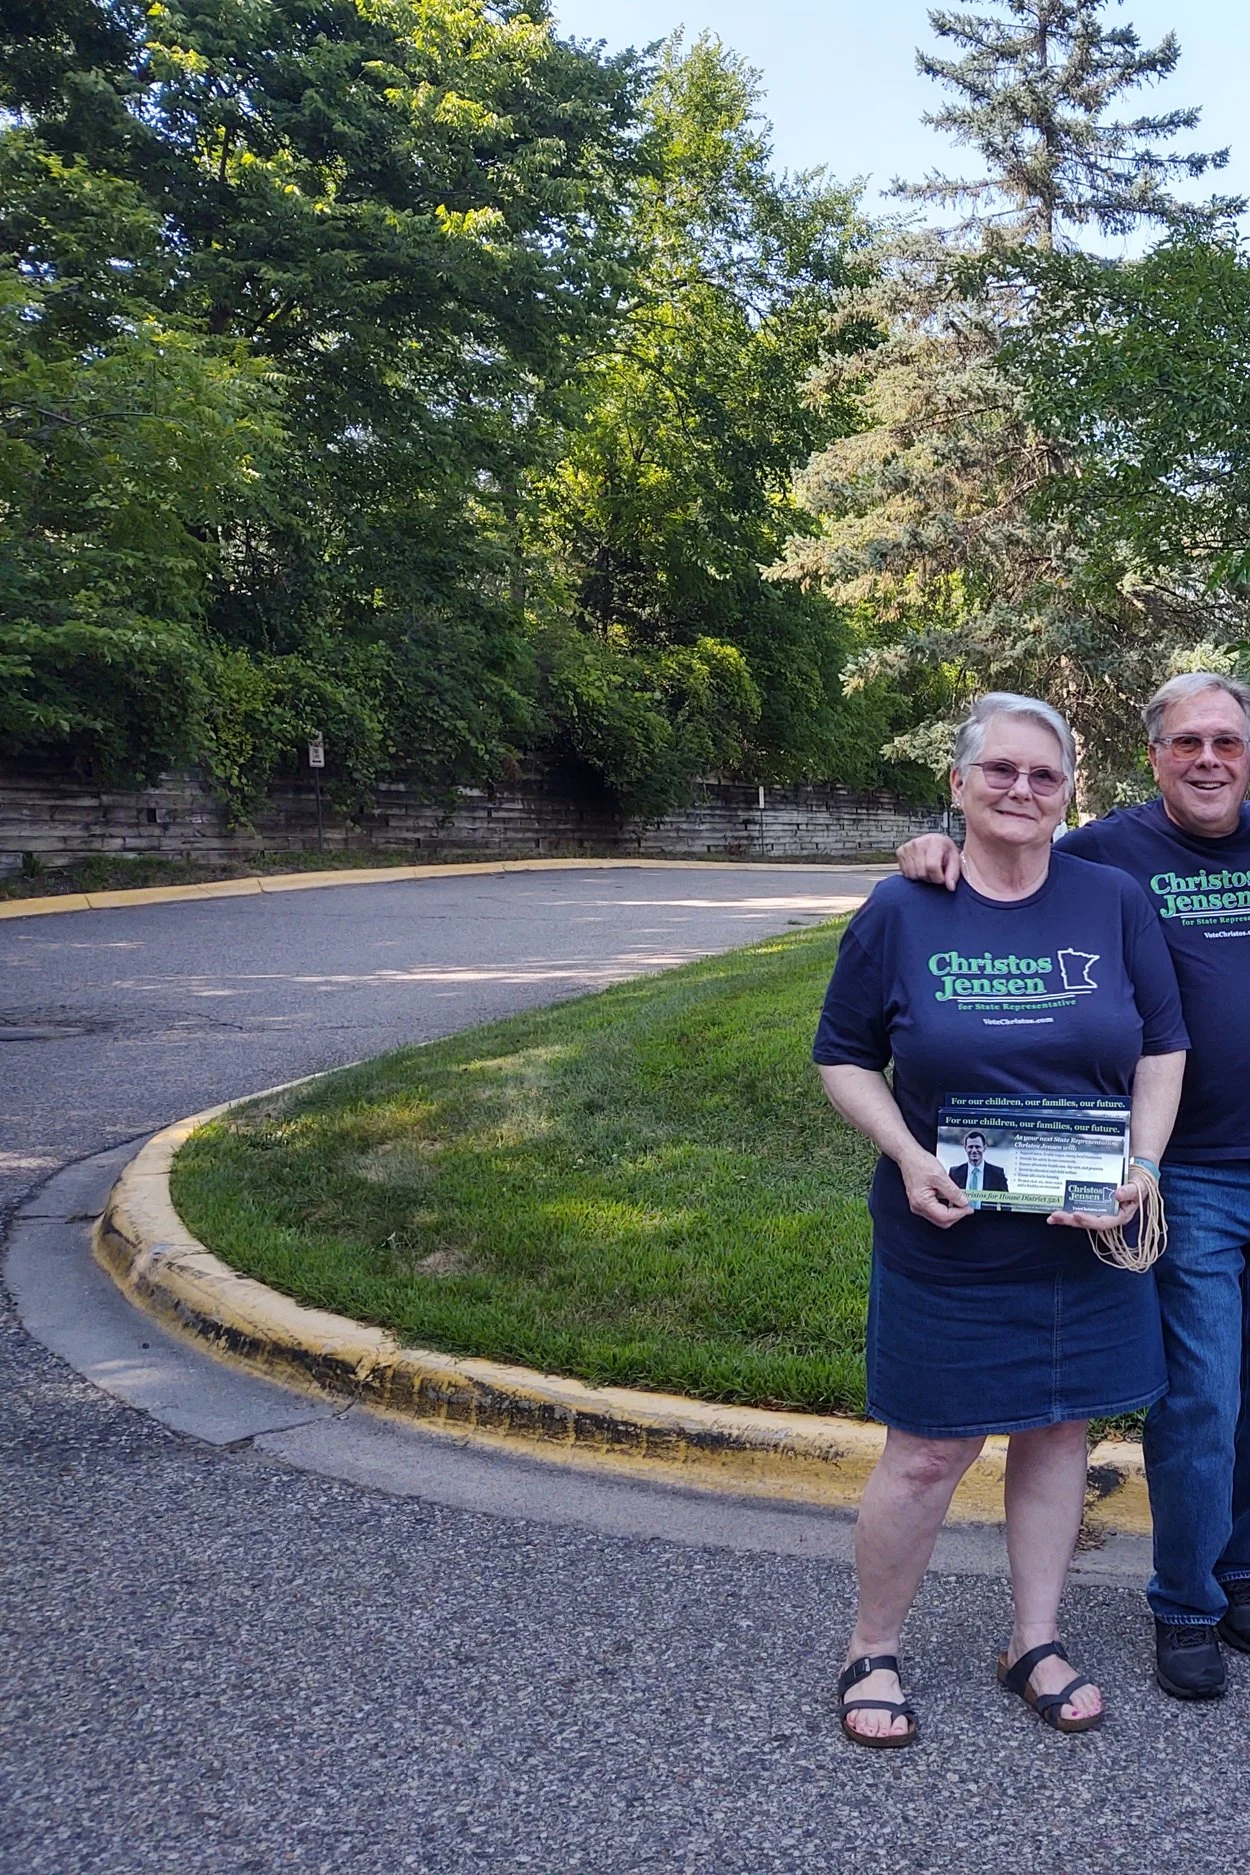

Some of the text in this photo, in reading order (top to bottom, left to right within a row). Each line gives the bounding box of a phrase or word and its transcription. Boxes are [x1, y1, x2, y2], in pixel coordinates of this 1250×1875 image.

[1182, 918, 1195, 926] for
[1196, 917, 1218, 925] State
[928, 951, 1053, 976] Christos
[935, 976, 1047, 1001] Jensen
[1002, 999, 1077, 1012] Representative
[951, 1097, 968, 1105] For
[985, 1097, 1023, 1106] children,
[1042, 1099, 1078, 1108] families,
[1096, 1100, 1126, 1108] future.
[945, 1116, 961, 1124] For
[979, 1118, 1018, 1128] children,
[1036, 1121, 1073, 1131] families,
[1091, 1124, 1120, 1133] future.
[1068, 1184, 1103, 1194] Christos
[964, 1190, 987, 1199] hristos
[987, 1192, 997, 1200] for
[1068, 1192, 1100, 1201] Jensen
